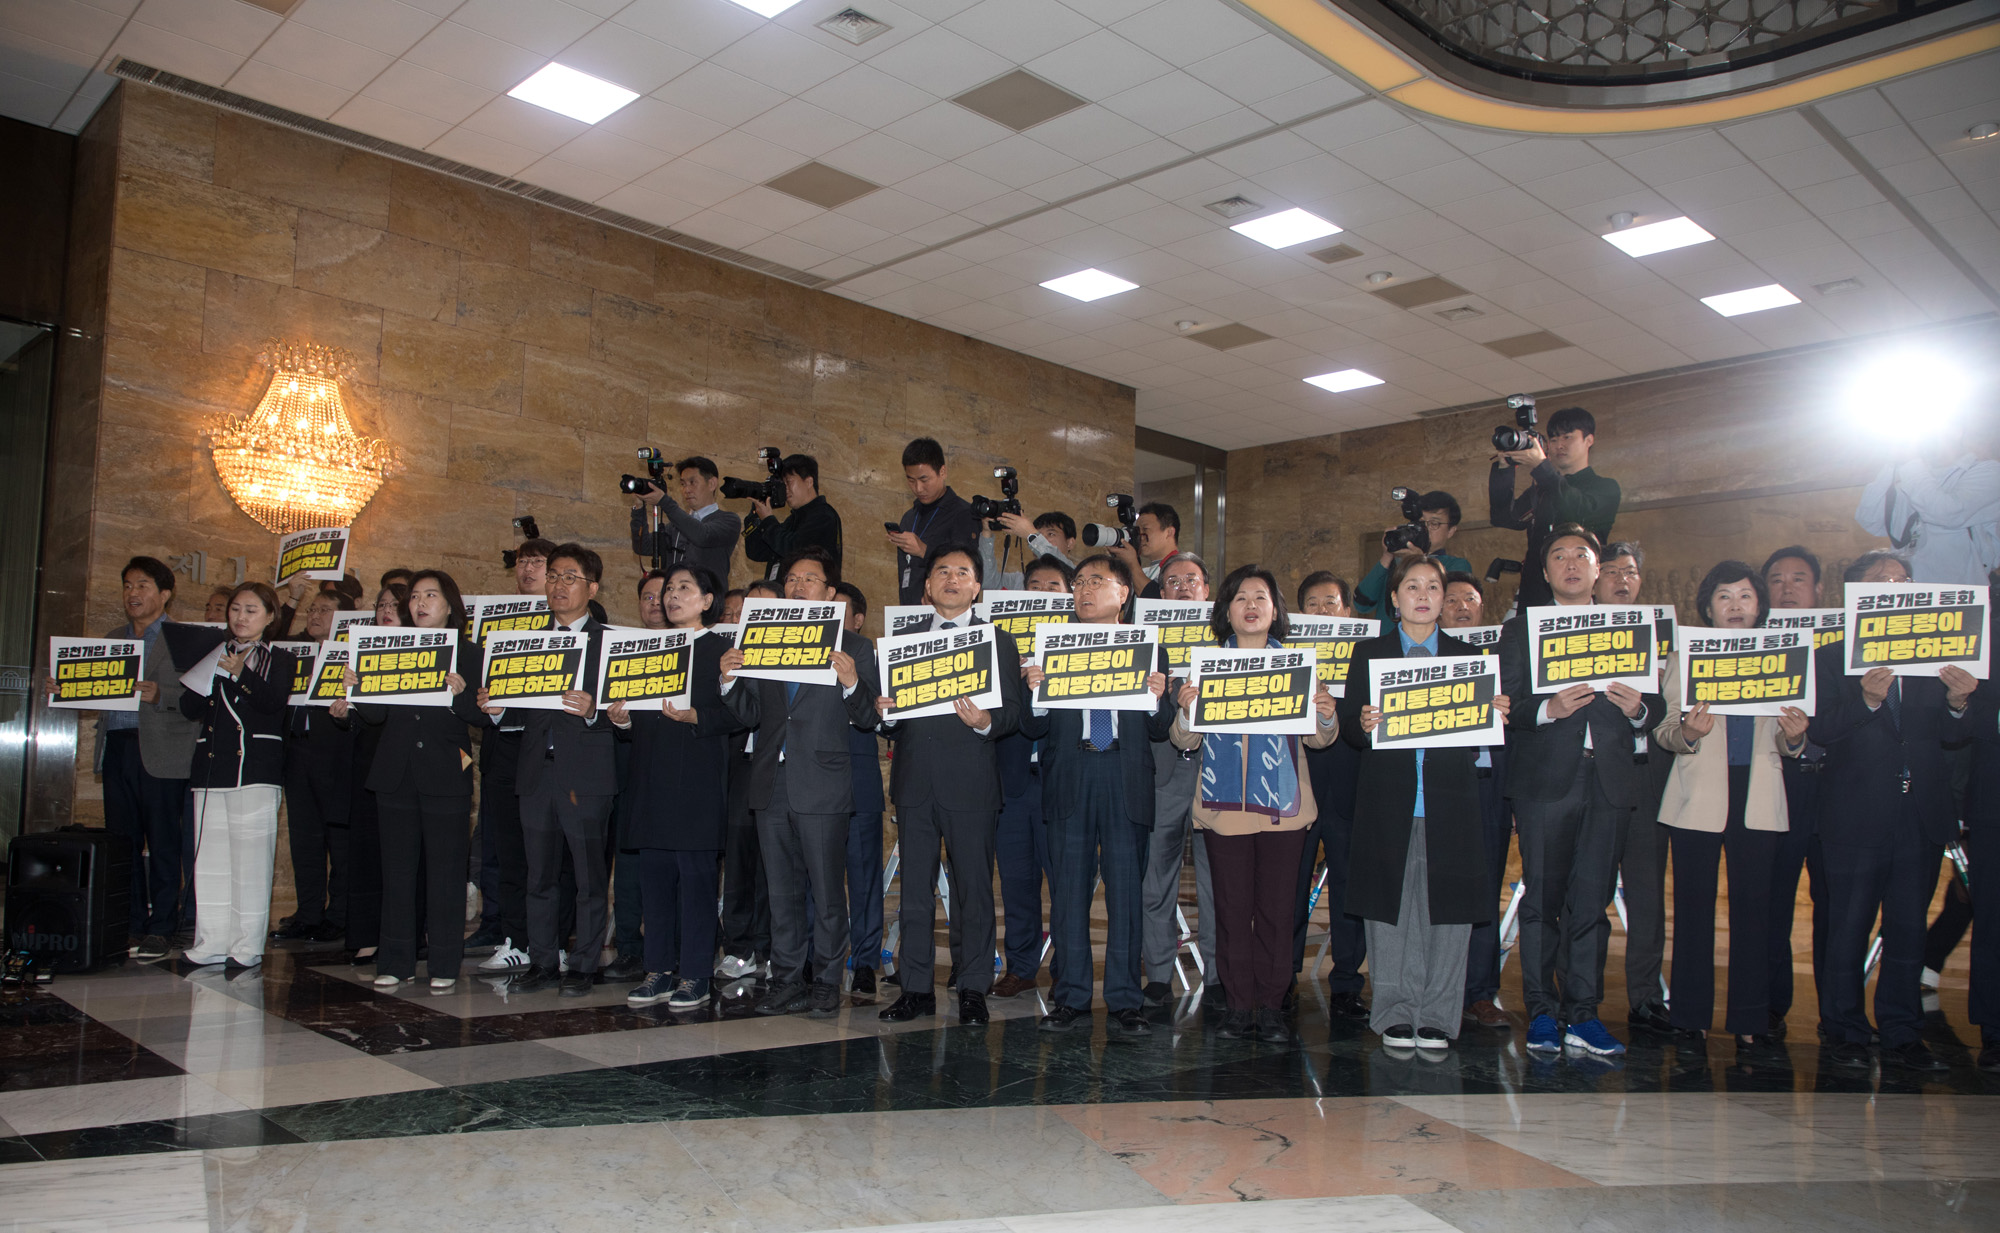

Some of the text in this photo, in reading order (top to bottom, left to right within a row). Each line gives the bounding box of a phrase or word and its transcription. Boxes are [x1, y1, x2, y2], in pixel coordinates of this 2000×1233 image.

[283, 530, 341, 550] 공천개입 통화
[282, 542, 332, 566] 대통령이
[280, 556, 337, 578] 해명하라!
[482, 601, 532, 616] 공천개입
[534, 600, 550, 611] 통
[991, 598, 1047, 614] 공천개입
[1856, 590, 1975, 610] 공천개입 통화
[748, 606, 835, 621] 공천개입 통화
[1144, 608, 1201, 622] 공천개입
[1539, 612, 1606, 632] 공천개입
[1612, 610, 1643, 625] 통화
[1858, 611, 1962, 638] 대통령이
[744, 625, 824, 644] 대통령이
[1044, 632, 1109, 648] 공천개입
[1114, 629, 1146, 644] 통화
[1338, 623, 1368, 636] 통화
[58, 644, 134, 658] 공천개입 통화
[358, 635, 416, 649] 공천개입
[420, 633, 448, 646] 통화
[492, 638, 544, 654] 공천개입
[548, 636, 576, 649] 통화
[609, 632, 686, 654] 공천개입 통화
[888, 630, 984, 662] 공천개입 통화
[1542, 630, 1634, 658] 대통령이
[1688, 636, 1756, 652] 공천개입
[1762, 633, 1800, 649] 통화
[1862, 634, 1978, 664] 해명하라!
[359, 651, 437, 672] 대통령이
[489, 654, 564, 676] 대통령이
[608, 652, 678, 678] 대통령이
[742, 646, 832, 666] 해명하라!
[1046, 649, 1134, 674] 대통령이
[1200, 653, 1304, 673] 공천개입 통화
[1547, 652, 1647, 682] 해명하라!
[1692, 654, 1786, 678] 대통령이
[58, 660, 126, 680] 대통령이
[892, 650, 974, 687] 대통령이
[1380, 660, 1486, 686] 공천개입 통화
[60, 678, 134, 698] 해명하라!
[360, 670, 446, 692] 해명하라!
[488, 674, 573, 696] 해명하라!
[608, 672, 686, 699] 해명하라!
[896, 670, 988, 708] 해명하라!
[1047, 670, 1146, 697] 해명하라!
[1201, 673, 1292, 698] 대통령이
[1695, 675, 1802, 702] 해명하라!
[1204, 694, 1304, 722] 해명하라!
[1383, 682, 1475, 714] 대통령이
[1386, 704, 1490, 737] 해명하라!
